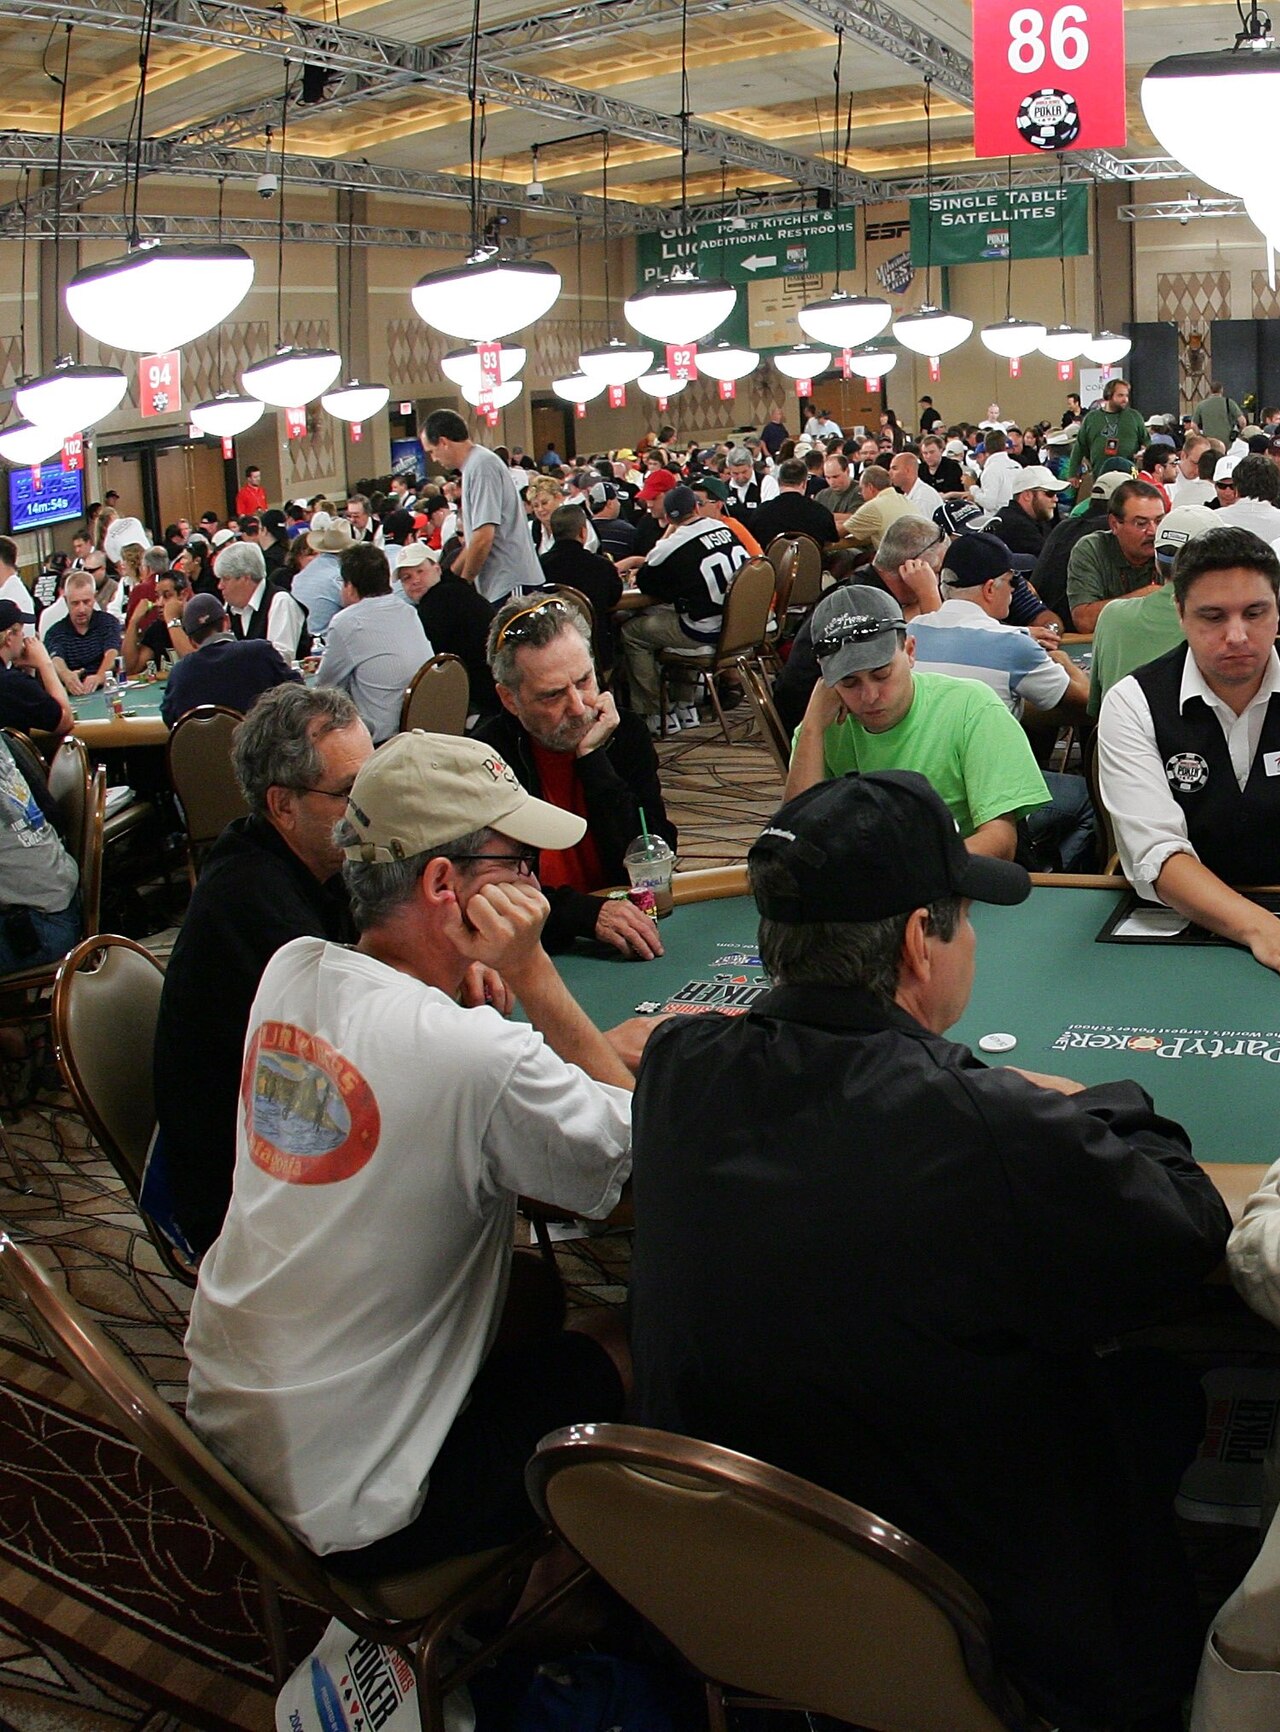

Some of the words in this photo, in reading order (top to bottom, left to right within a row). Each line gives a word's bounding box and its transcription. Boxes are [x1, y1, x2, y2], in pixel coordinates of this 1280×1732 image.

[1007, 4, 1090, 74] 86
[1034, 105, 1062, 118] POKER
[929, 195, 998, 212] SINGLE
[1005, 189, 1068, 206] TABLE
[717, 220, 759, 235] POER
[762, 213, 819, 228] KITCHEN
[823, 211, 834, 221] &
[940, 206, 1057, 227] SATELLITES
[699, 232, 774, 251] ADDITIONAL
[777, 222, 854, 240] RESTROOMS
[482, 351, 498, 369] 93
[673, 350, 691, 366] 92
[148, 363, 172, 389] 94
[63, 439, 82, 456] 102
[26, 497, 69, 516] 14m:54s
[699, 529, 733, 551] WSOP
[673, 981, 771, 1007] OKER
[1068, 1023, 1116, 1032] School
[1117, 1025, 1157, 1035] Poker
[1160, 1026, 1210, 1037] Largest
[1212, 1029, 1261, 1039] World's
[347, 1636, 400, 1732] POKER
[391, 1654, 417, 1695] SERIES
